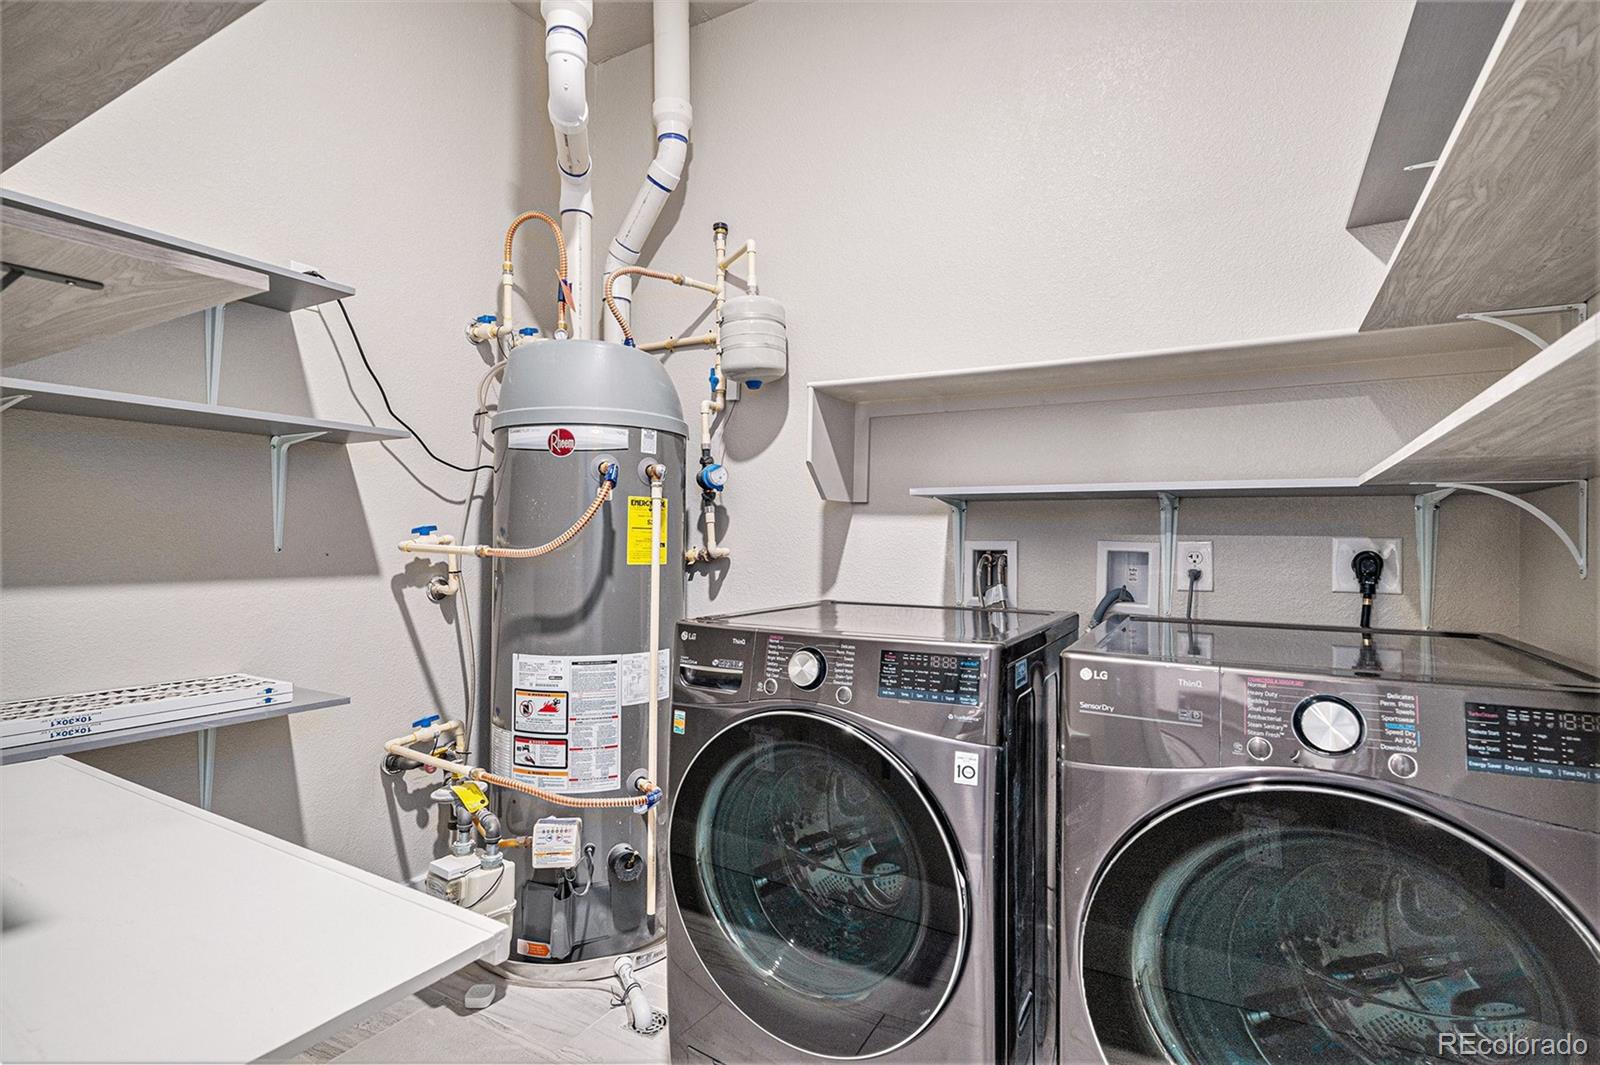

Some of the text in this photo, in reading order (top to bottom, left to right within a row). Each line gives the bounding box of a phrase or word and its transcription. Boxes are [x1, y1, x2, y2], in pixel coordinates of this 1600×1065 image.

[550, 430, 575, 453] Rheem
[1094, 670, 1108, 680] LG
[1178, 679, 1203, 688] ThinQ
[1387, 692, 1414, 700] Delicates
[50, 716, 92, 727] 10x30x1
[50, 727, 92, 738] 10x30x1
[1380, 744, 1417, 753] Downloaded
[957, 764, 976, 779] 10
